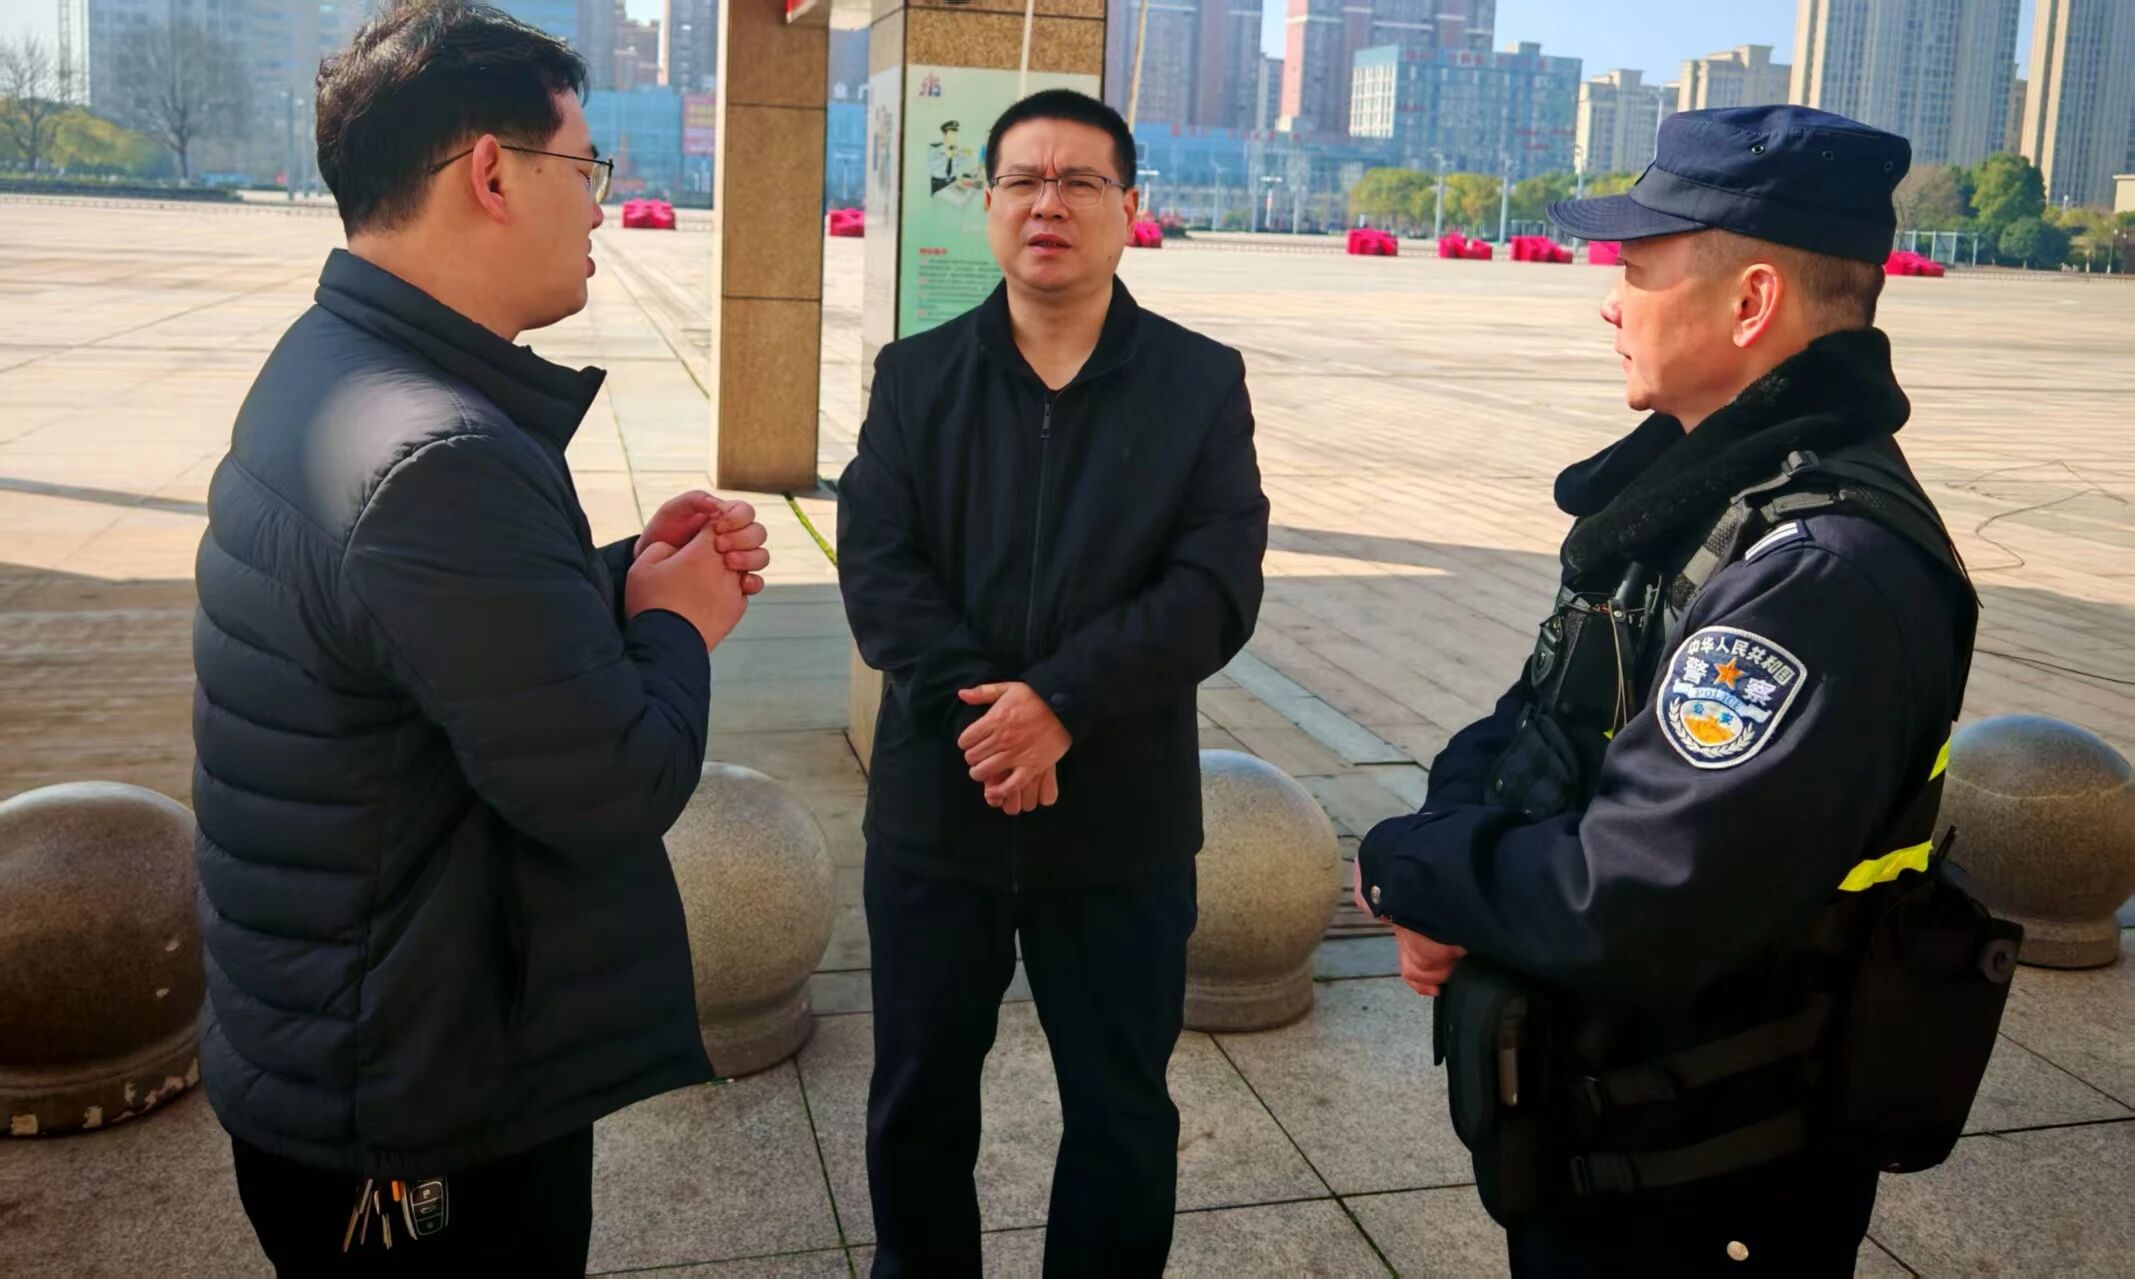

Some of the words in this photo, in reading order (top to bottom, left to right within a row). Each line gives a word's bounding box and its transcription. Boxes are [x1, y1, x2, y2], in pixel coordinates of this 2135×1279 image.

[1687, 636, 1795, 686] 中华人民共和国
[1696, 689, 1742, 710] POLICE
